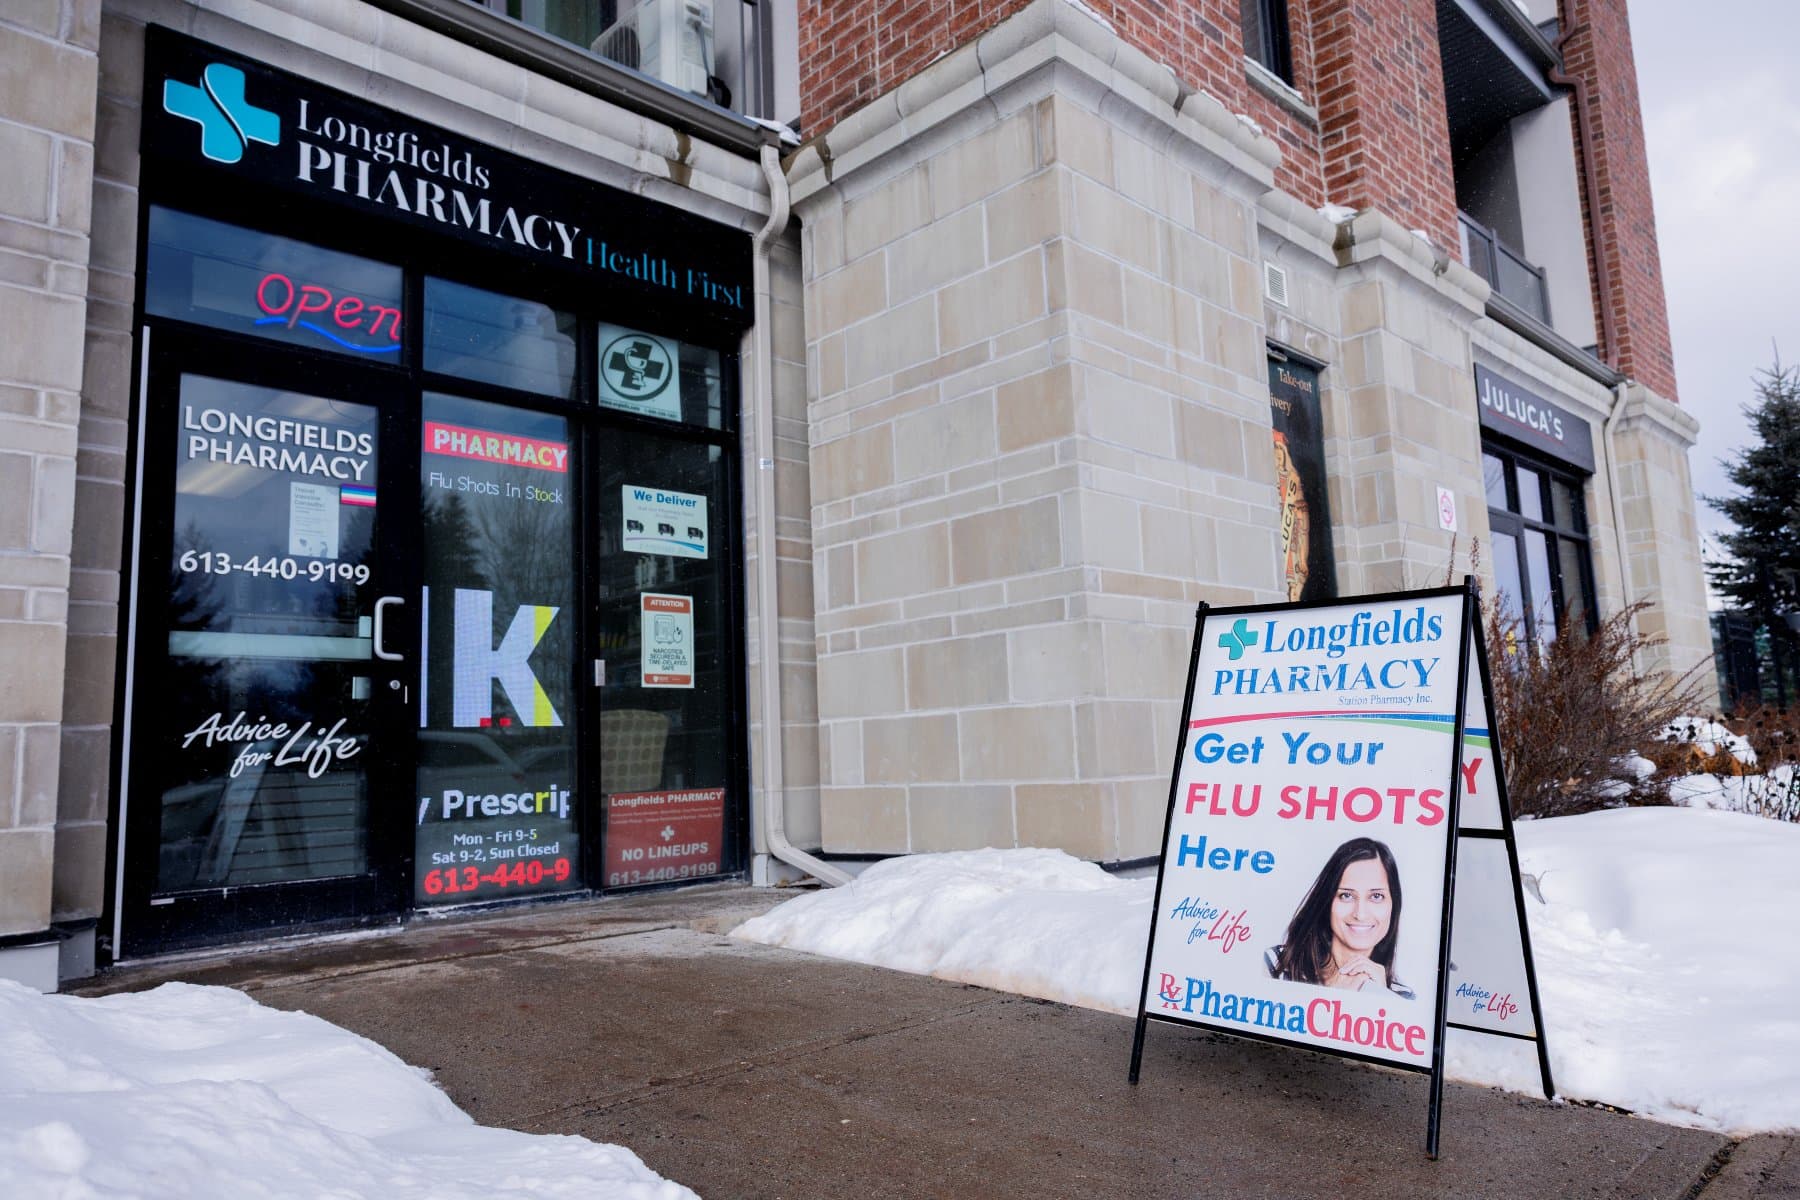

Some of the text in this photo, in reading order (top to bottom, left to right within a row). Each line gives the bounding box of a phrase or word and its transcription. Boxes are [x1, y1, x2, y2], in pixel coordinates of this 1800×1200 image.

[297, 98, 491, 190] Longfields
[297, 141, 581, 260] PHARMACY
[586, 237, 744, 310] Health First
[257, 273, 402, 342] Open
[1277, 367, 1312, 393] Take-out
[1481, 378, 1564, 441] JULUCA'S
[184, 405, 373, 456] LONGFIELDS
[433, 428, 568, 469] PHARMACY
[188, 435, 369, 481] PHARMACY
[429, 472, 564, 505] Flu Shots In Stock
[633, 489, 697, 508] We Deliver
[179, 550, 371, 586] 613-440-9199
[650, 599, 685, 608] ATTENTION
[1263, 607, 1442, 659] Longfields
[1212, 657, 1440, 696] PHARMACY
[1338, 693, 1433, 706] Station Pharmacy Inc.
[182, 711, 291, 748] Advice
[230, 718, 361, 778] for Life
[1194, 732, 1384, 766] Get Your
[611, 791, 722, 808] Longfields PHARMACY
[1184, 783, 1445, 826] FLU SHOTS
[432, 852, 456, 865] Sat
[490, 847, 515, 860] Sun
[517, 842, 559, 857] Closed
[453, 833, 483, 847] Mon
[495, 830, 513, 843] Fri
[515, 829, 538, 841] 9-5
[622, 842, 709, 861] NO LINEUPS
[1176, 834, 1276, 874] Here
[424, 858, 570, 895] 613-440-9
[610, 862, 717, 886] 613-440-9199
[1170, 896, 1218, 921] Advice
[1187, 910, 1251, 953] for Life
[1455, 982, 1490, 998] Advice
[1473, 993, 1518, 1020] for Life
[1182, 976, 1426, 1056] PharmaChoice
